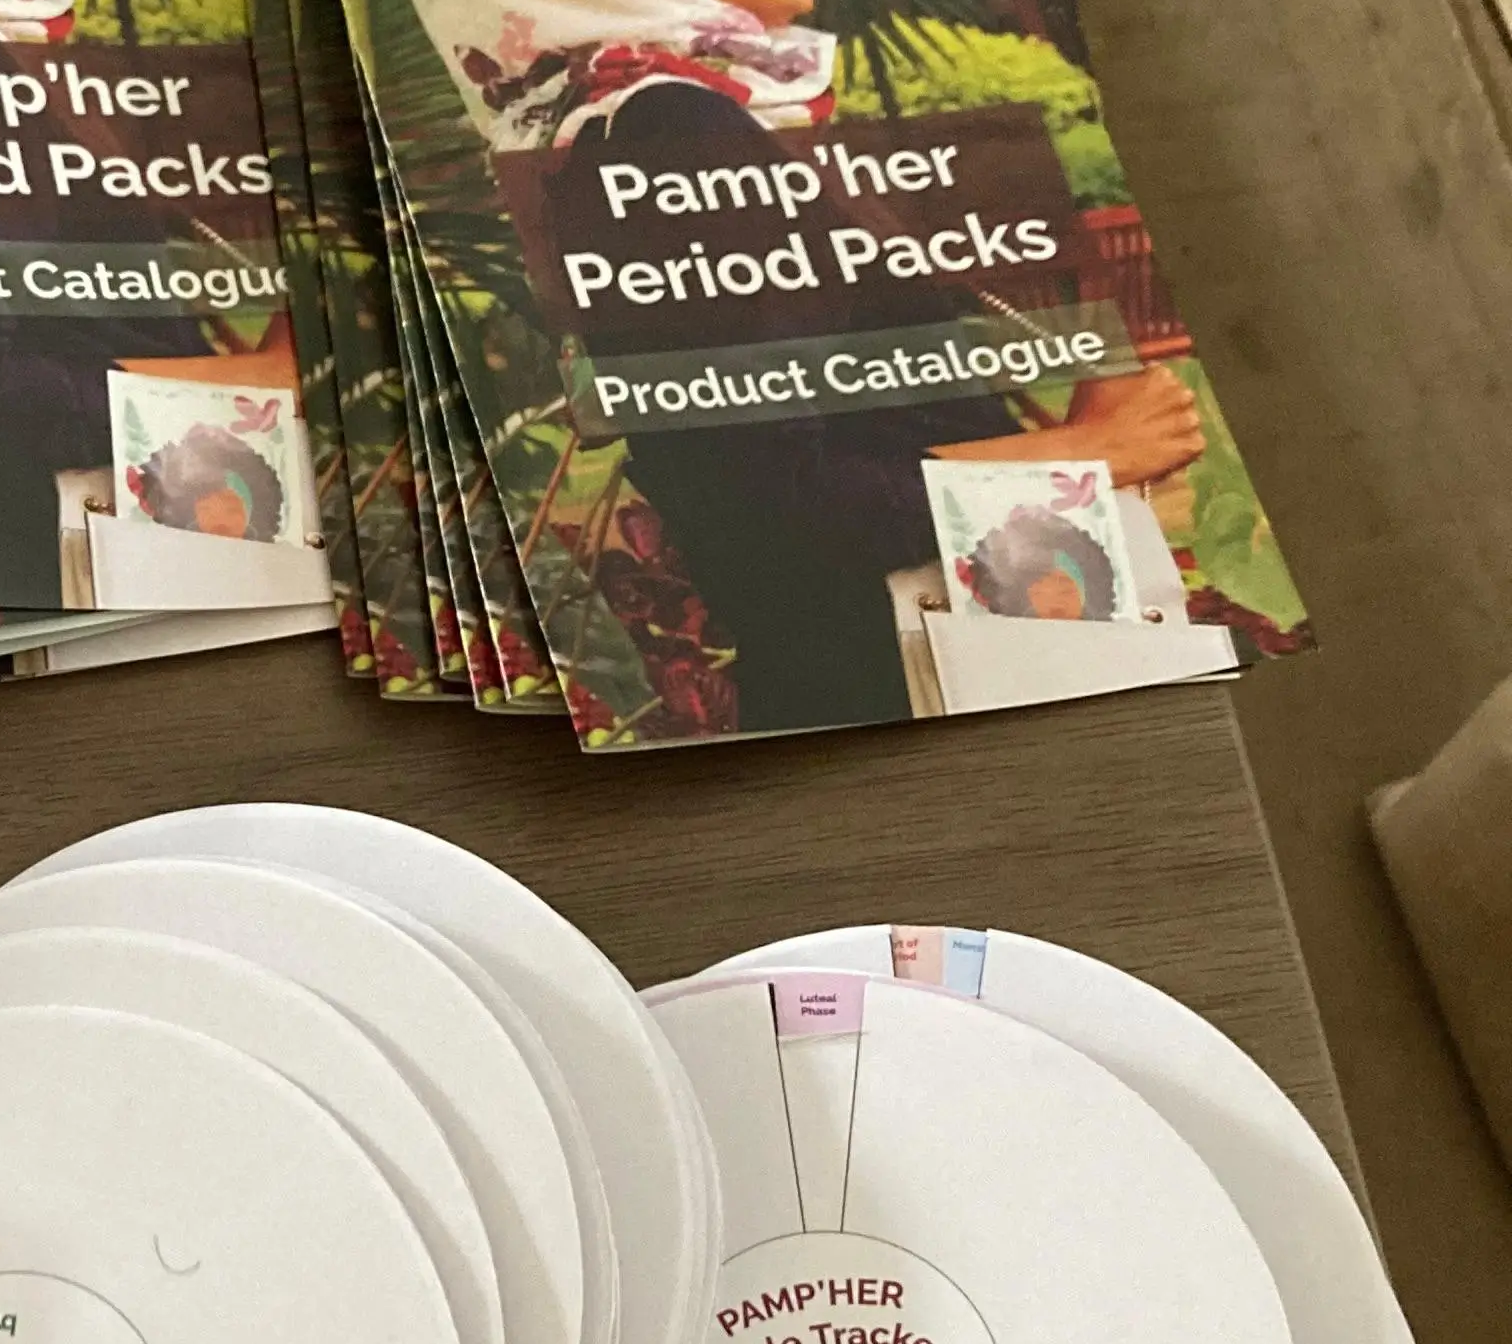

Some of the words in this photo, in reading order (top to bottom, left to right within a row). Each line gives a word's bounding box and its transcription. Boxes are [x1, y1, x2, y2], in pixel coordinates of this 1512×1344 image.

[47, 142, 274, 198] Packs
[599, 143, 959, 220] Pamp'her
[563, 233, 819, 309] Period
[828, 212, 1058, 284] Packs
[594, 361, 815, 417] Product
[823, 329, 1106, 395] Catalogue
[800, 993, 837, 1003] Luteal
[801, 1006, 836, 1016] Phase
[716, 1278, 904, 1337] PAMP'HER
